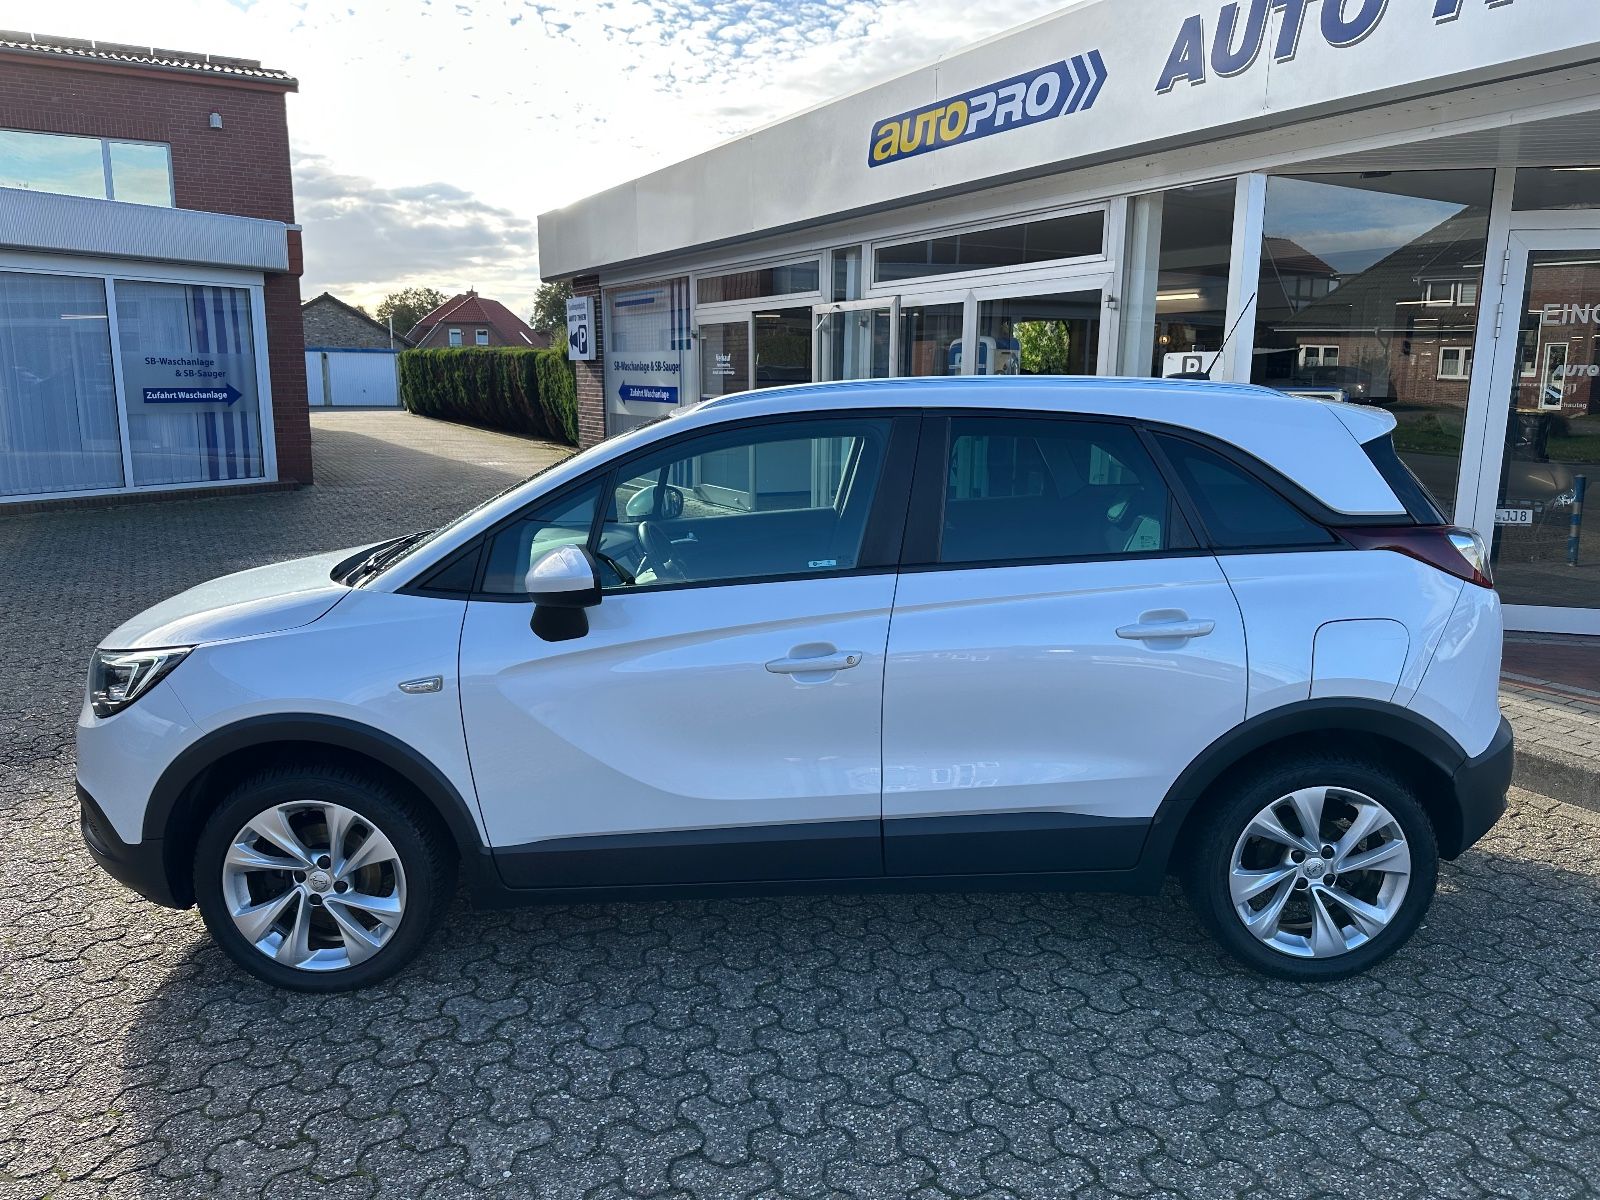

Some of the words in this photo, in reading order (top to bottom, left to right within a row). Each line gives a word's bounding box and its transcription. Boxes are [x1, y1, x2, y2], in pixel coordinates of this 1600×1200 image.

[1154, 0, 1389, 95] AUTO
[144, 357, 215, 368] SB-Waschanlage
[613, 361, 650, 374] SB-Waschanlage
[650, 360, 655, 372] &
[655, 361, 681, 375] SB-Sauger
[175, 369, 182, 377] &
[183, 369, 227, 379] SB-Sauger
[1552, 364, 1600, 377] AUTO
[146, 391, 177, 400] Zufahrt
[177, 391, 228, 400] Waschanlage
[629, 388, 644, 398] Zufahrt
[644, 389, 670, 401] Waschanlage
